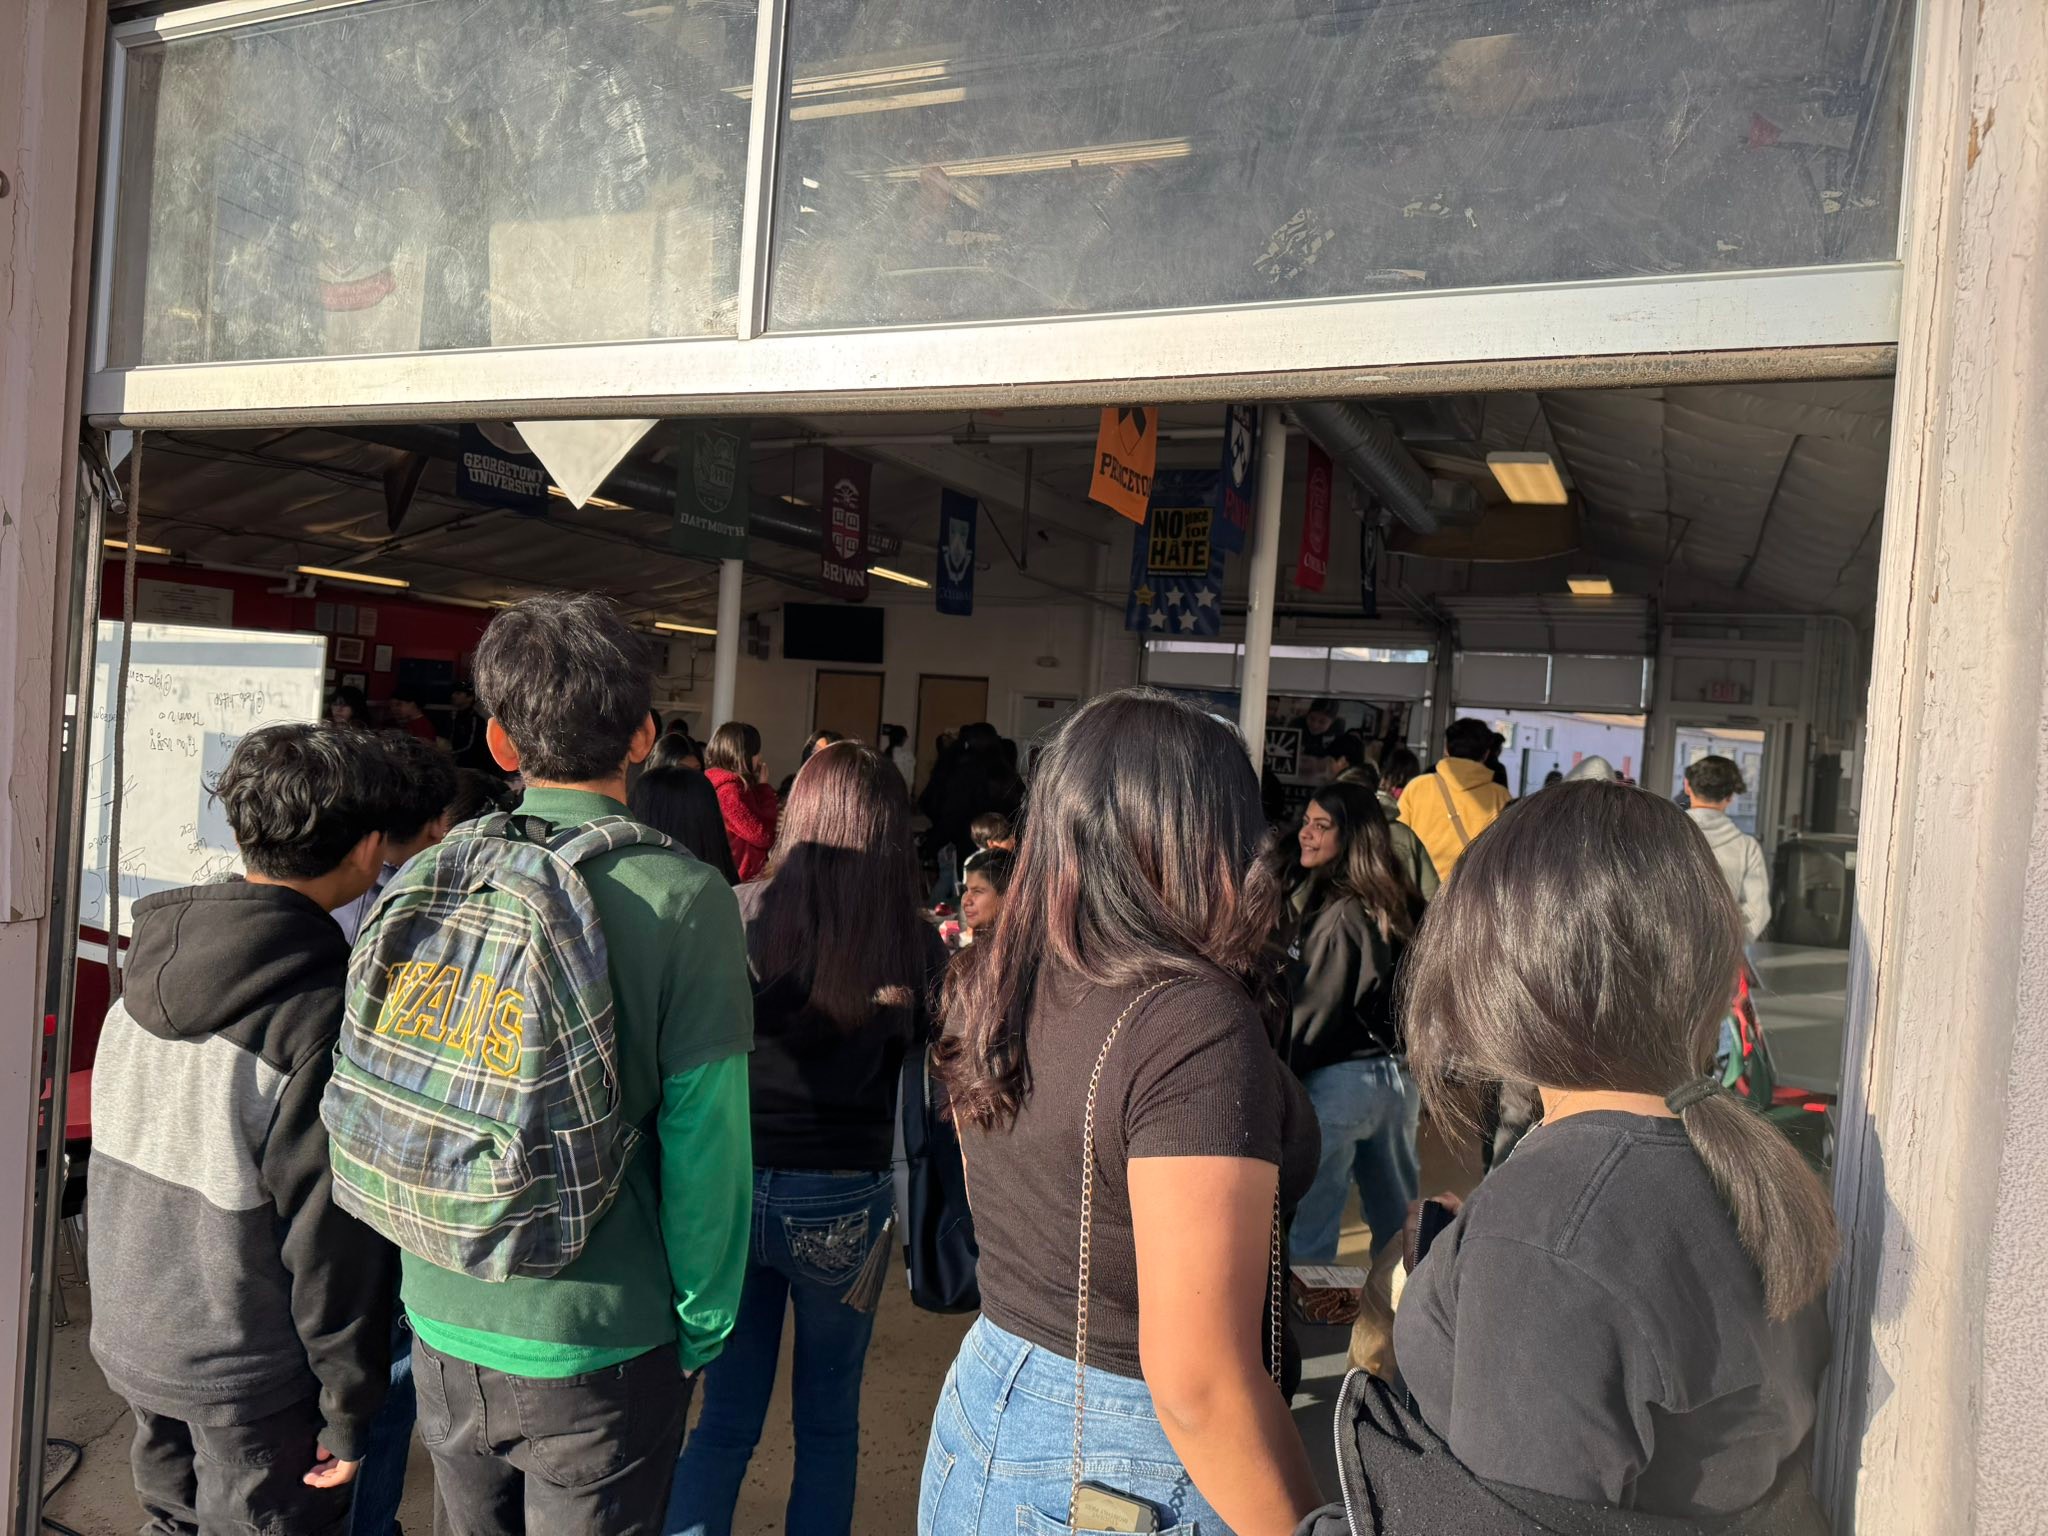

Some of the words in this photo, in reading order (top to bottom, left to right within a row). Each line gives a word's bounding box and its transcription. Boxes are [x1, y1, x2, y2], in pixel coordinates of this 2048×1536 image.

[680, 512, 745, 537] DARTMOUTH
[1153, 510, 1183, 538] NO
[1185, 526, 1208, 538] for
[1150, 540, 1207, 566] HATE
[374, 960, 525, 1077] VANS
